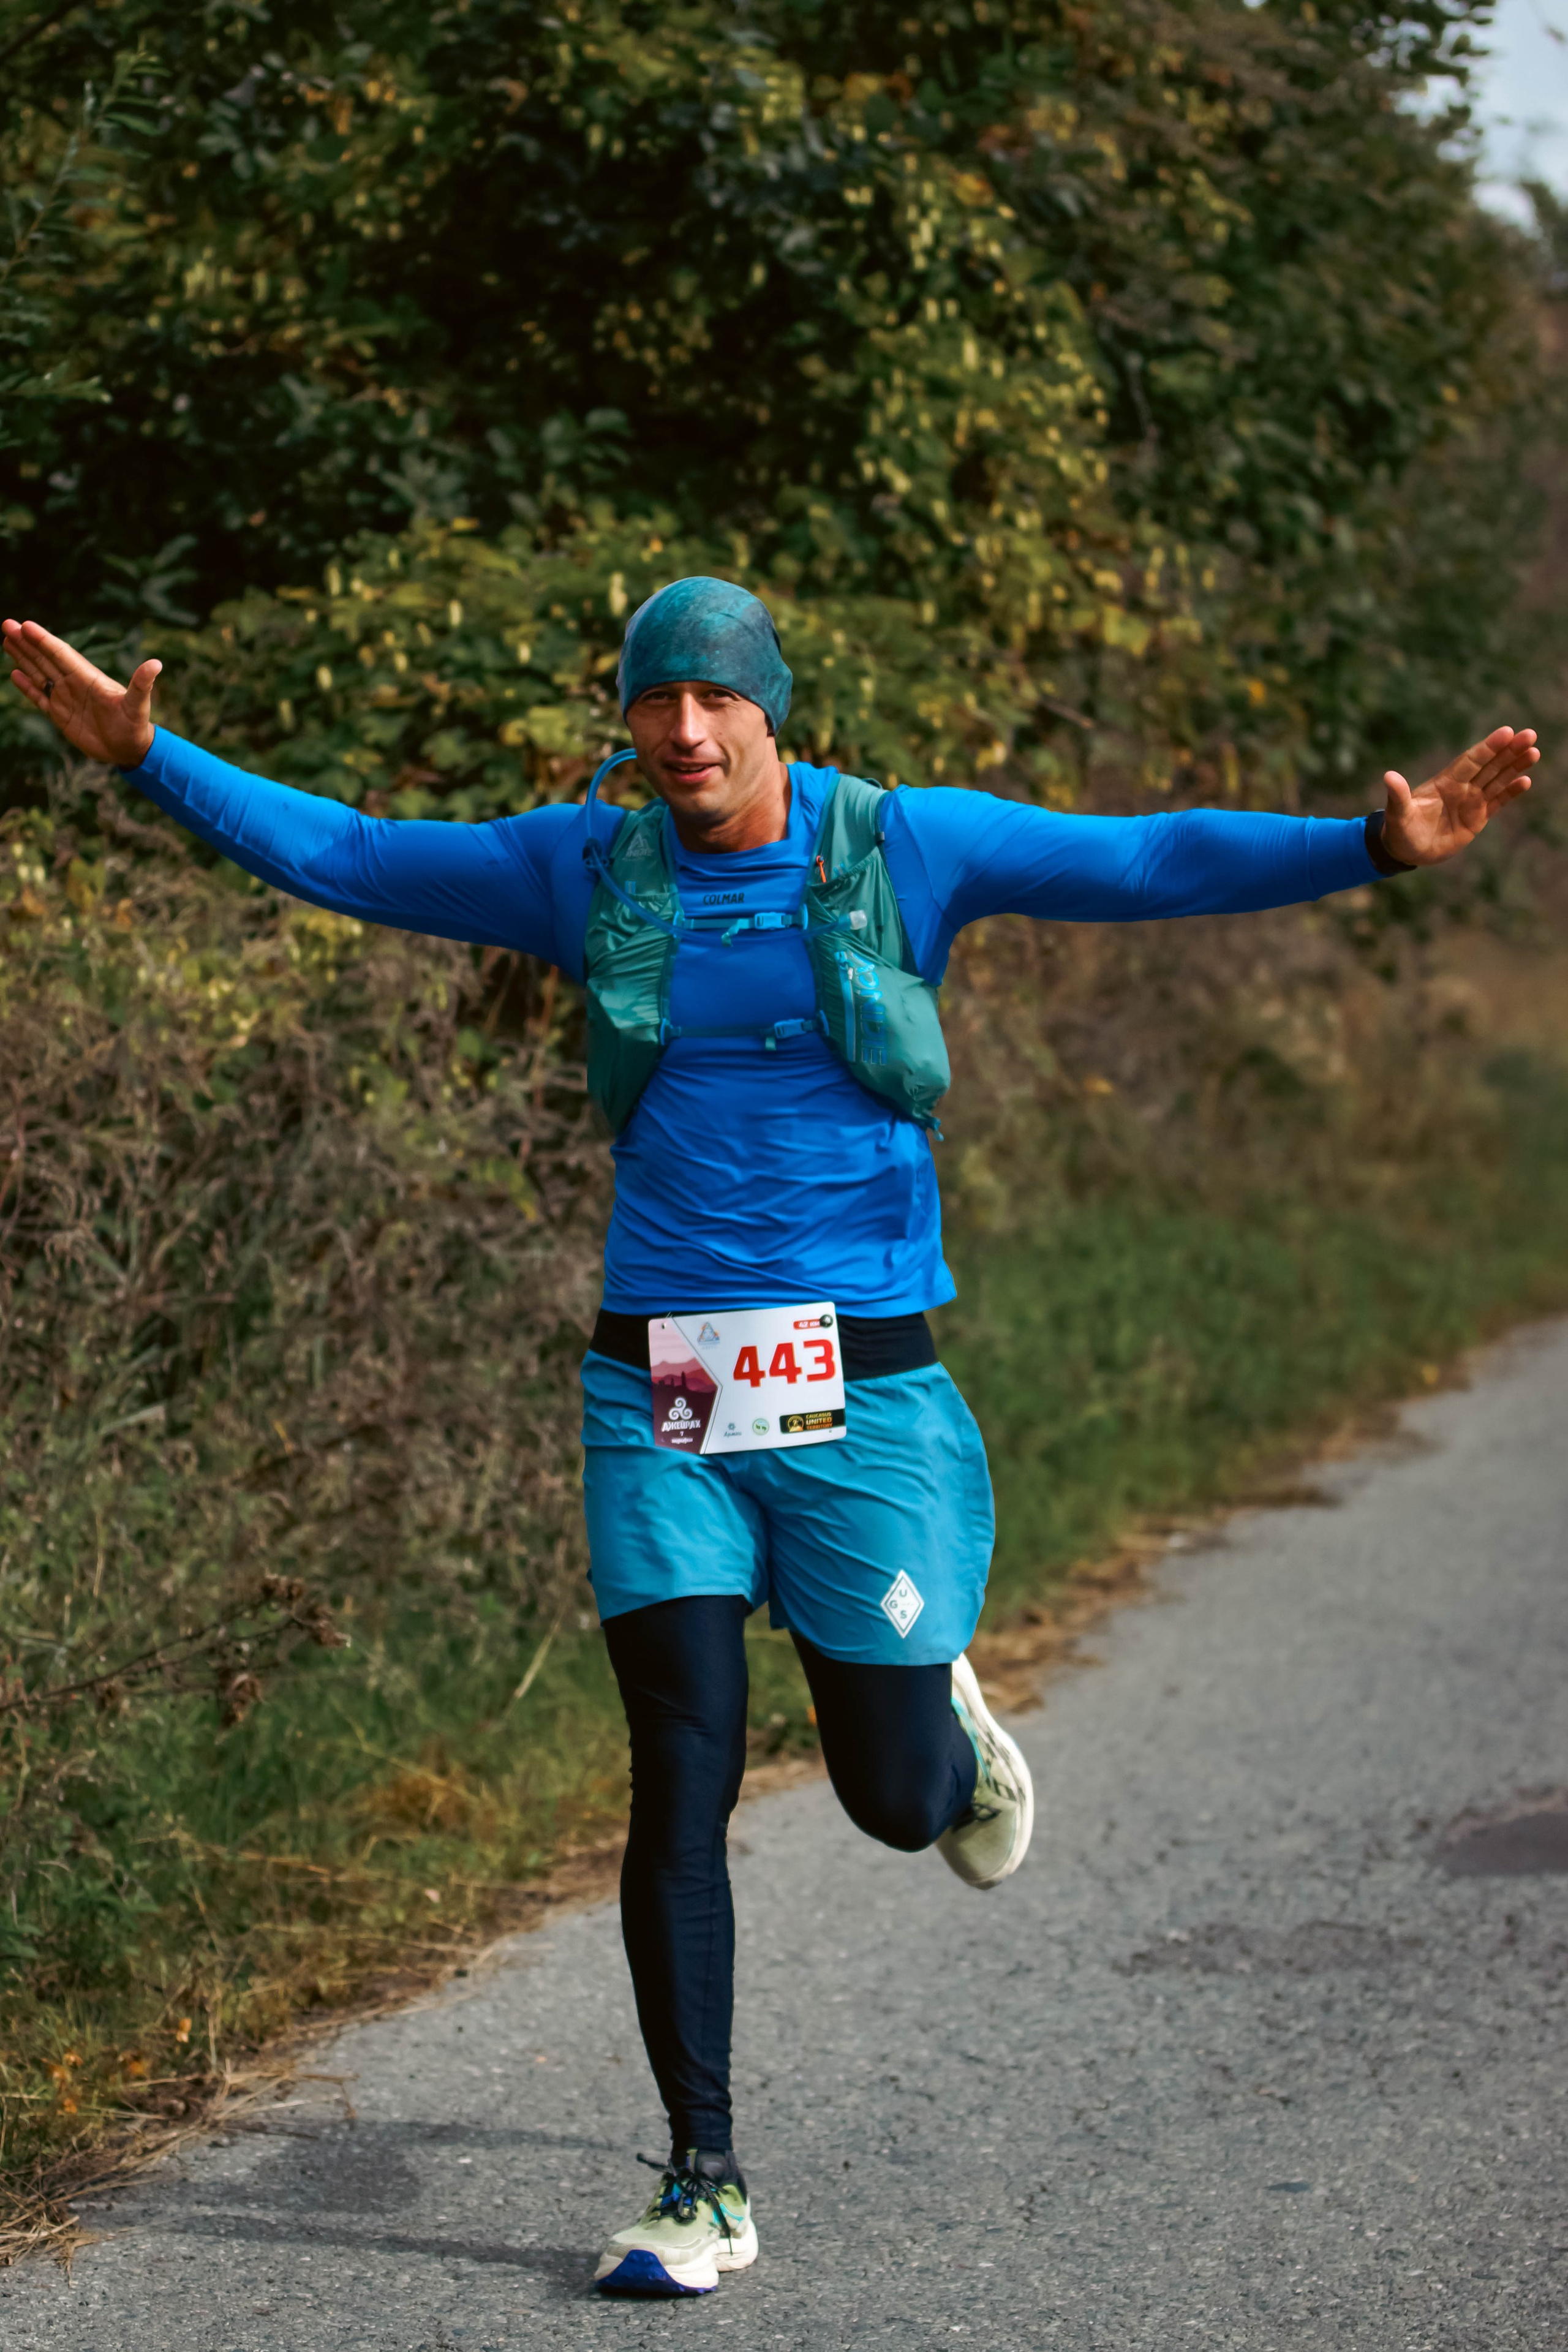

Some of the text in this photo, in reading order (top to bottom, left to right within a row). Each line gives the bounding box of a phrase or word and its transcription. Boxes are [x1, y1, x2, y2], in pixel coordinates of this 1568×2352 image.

[704, 892, 744, 905] COLMAR
[733, 1339, 837, 1388] 443
[662, 1420, 701, 1432] ДЖЕЙРАХ
